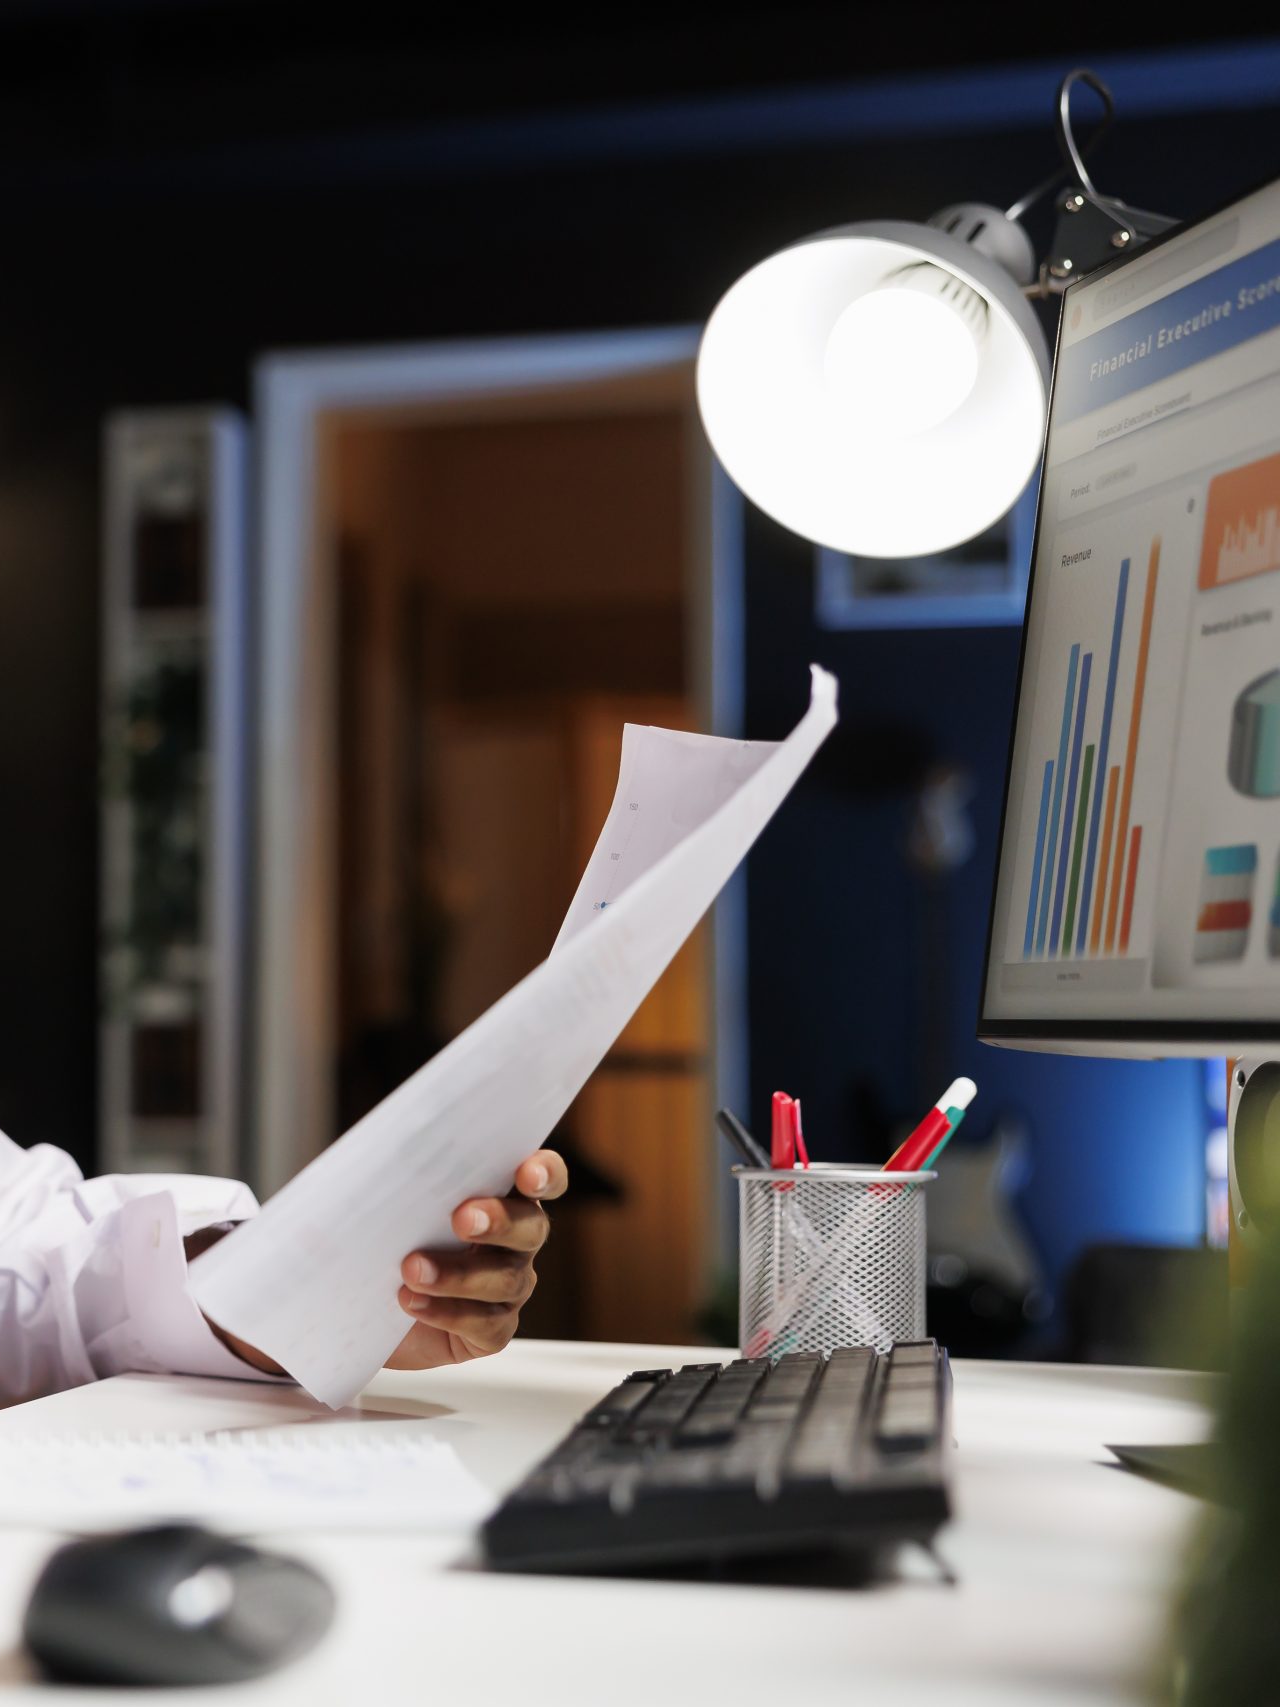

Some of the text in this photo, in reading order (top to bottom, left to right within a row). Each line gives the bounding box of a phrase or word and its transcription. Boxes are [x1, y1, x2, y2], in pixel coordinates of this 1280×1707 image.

[1089, 335, 1152, 382] Financial
[1157, 301, 1232, 349] Executive
[1061, 549, 1092, 568] Revenue
